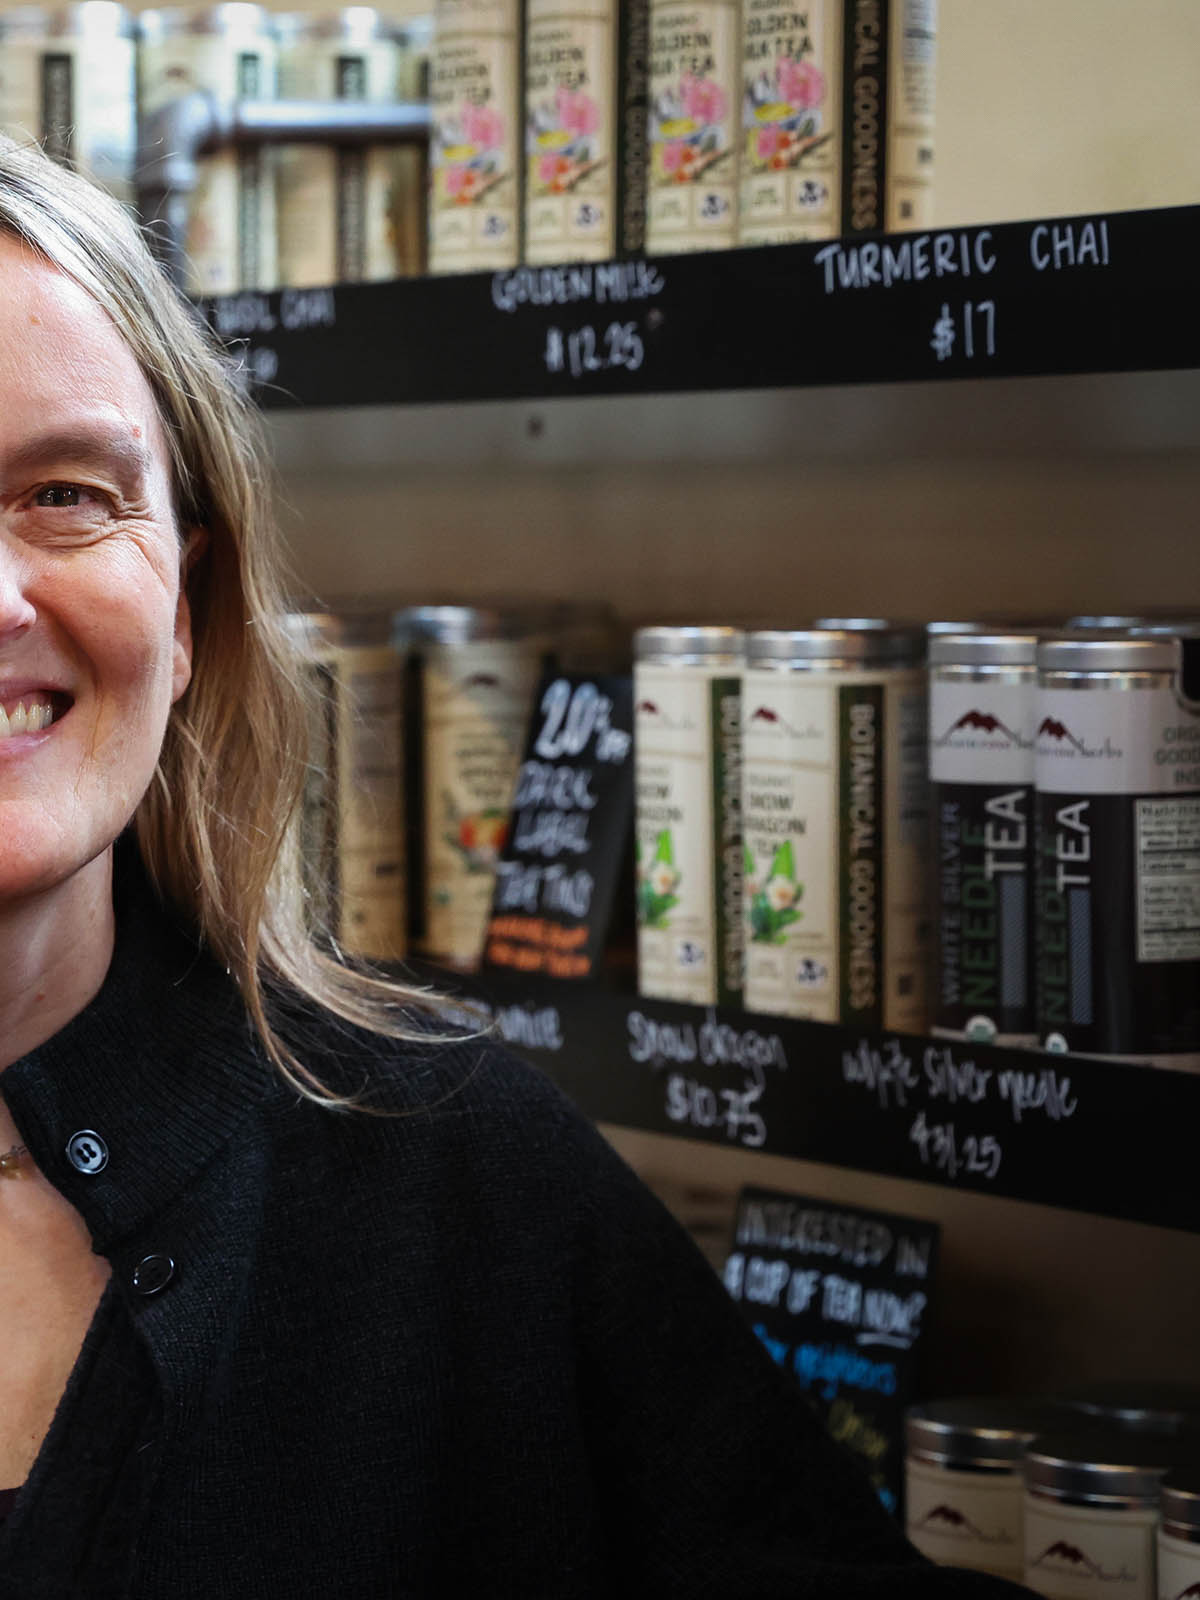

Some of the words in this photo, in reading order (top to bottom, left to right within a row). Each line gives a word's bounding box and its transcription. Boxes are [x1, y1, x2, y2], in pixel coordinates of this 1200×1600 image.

[853, 74, 879, 230] GOODNESS
[814, 231, 997, 293] TURMERIC
[1030, 220, 1109, 270] CHAI
[545, 322, 645, 378] $12.25
[930, 301, 996, 361] $17
[850, 703, 876, 856] BOTANICAL
[984, 790, 1028, 880] TEA
[1056, 801, 1091, 891] TEA
[850, 857, 876, 1010] GOODNESS
